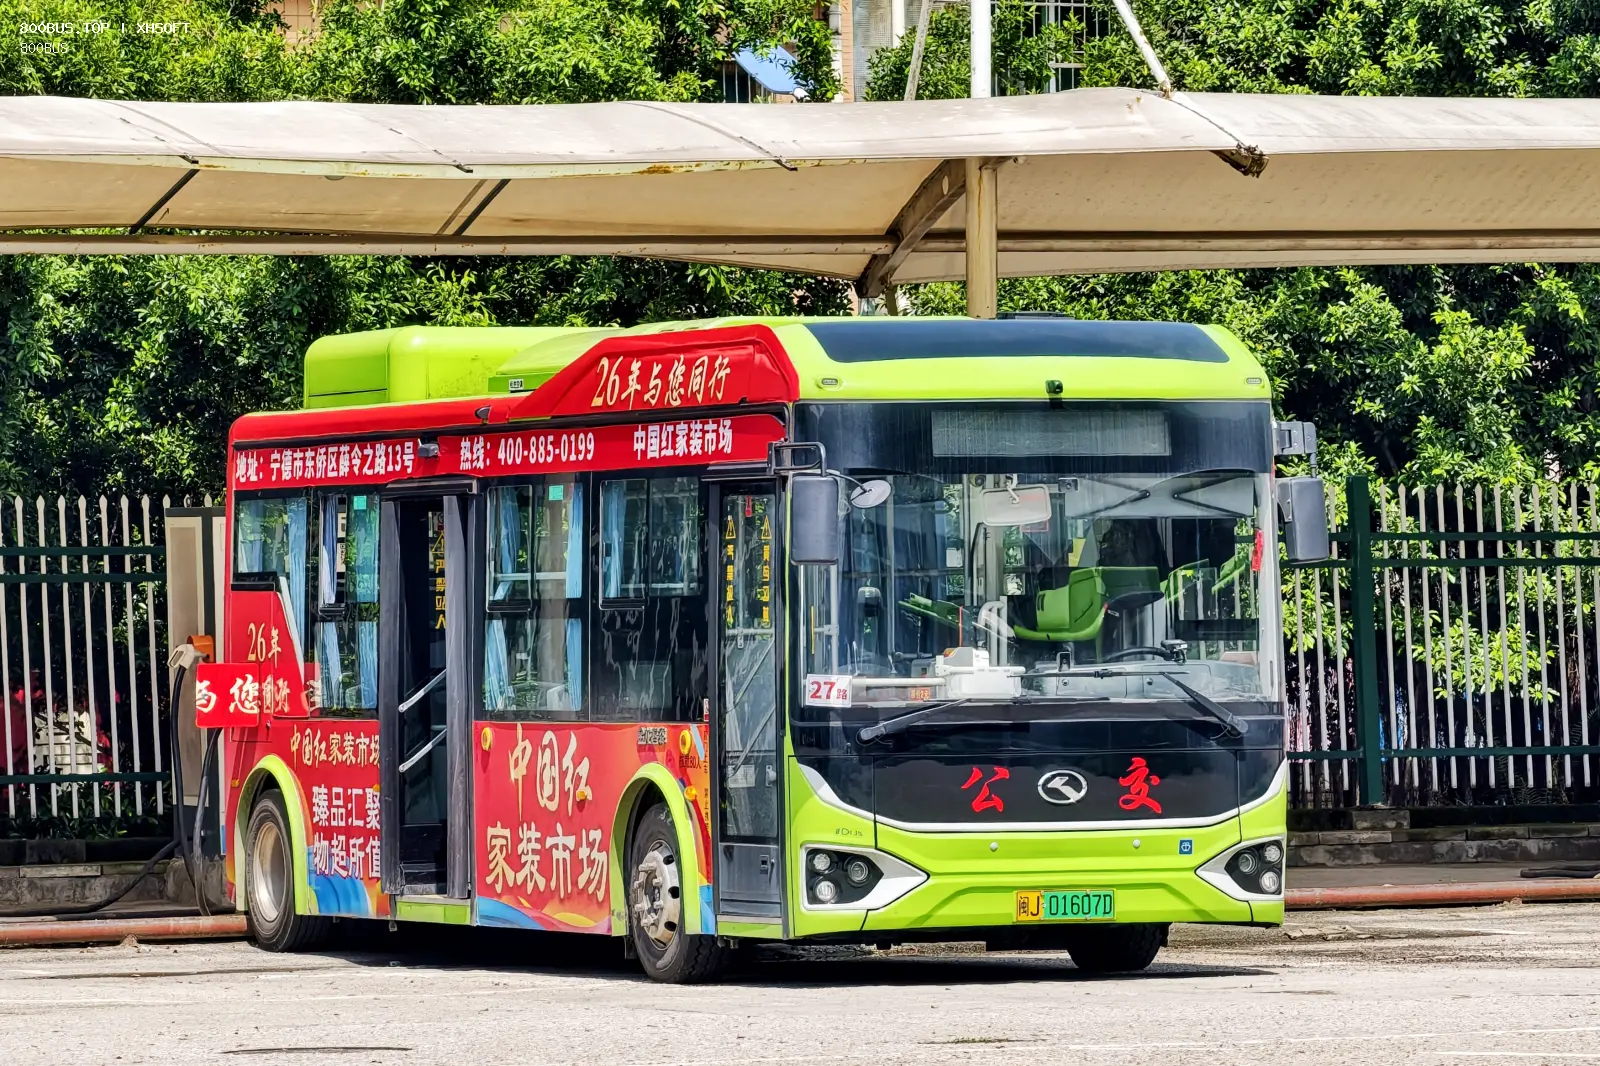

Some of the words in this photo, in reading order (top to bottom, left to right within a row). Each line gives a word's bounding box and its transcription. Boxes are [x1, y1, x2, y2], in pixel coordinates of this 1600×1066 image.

[591, 355, 730, 409] 26年与您同行
[633, 419, 733, 461] 中国红家装市场
[247, 622, 281, 668] 26年
[509, 723, 593, 820] 中国红
[312, 784, 380, 830] 臻品汇聚
[313, 832, 380, 881] 物超所值
[485, 821, 608, 902] 家装市场
